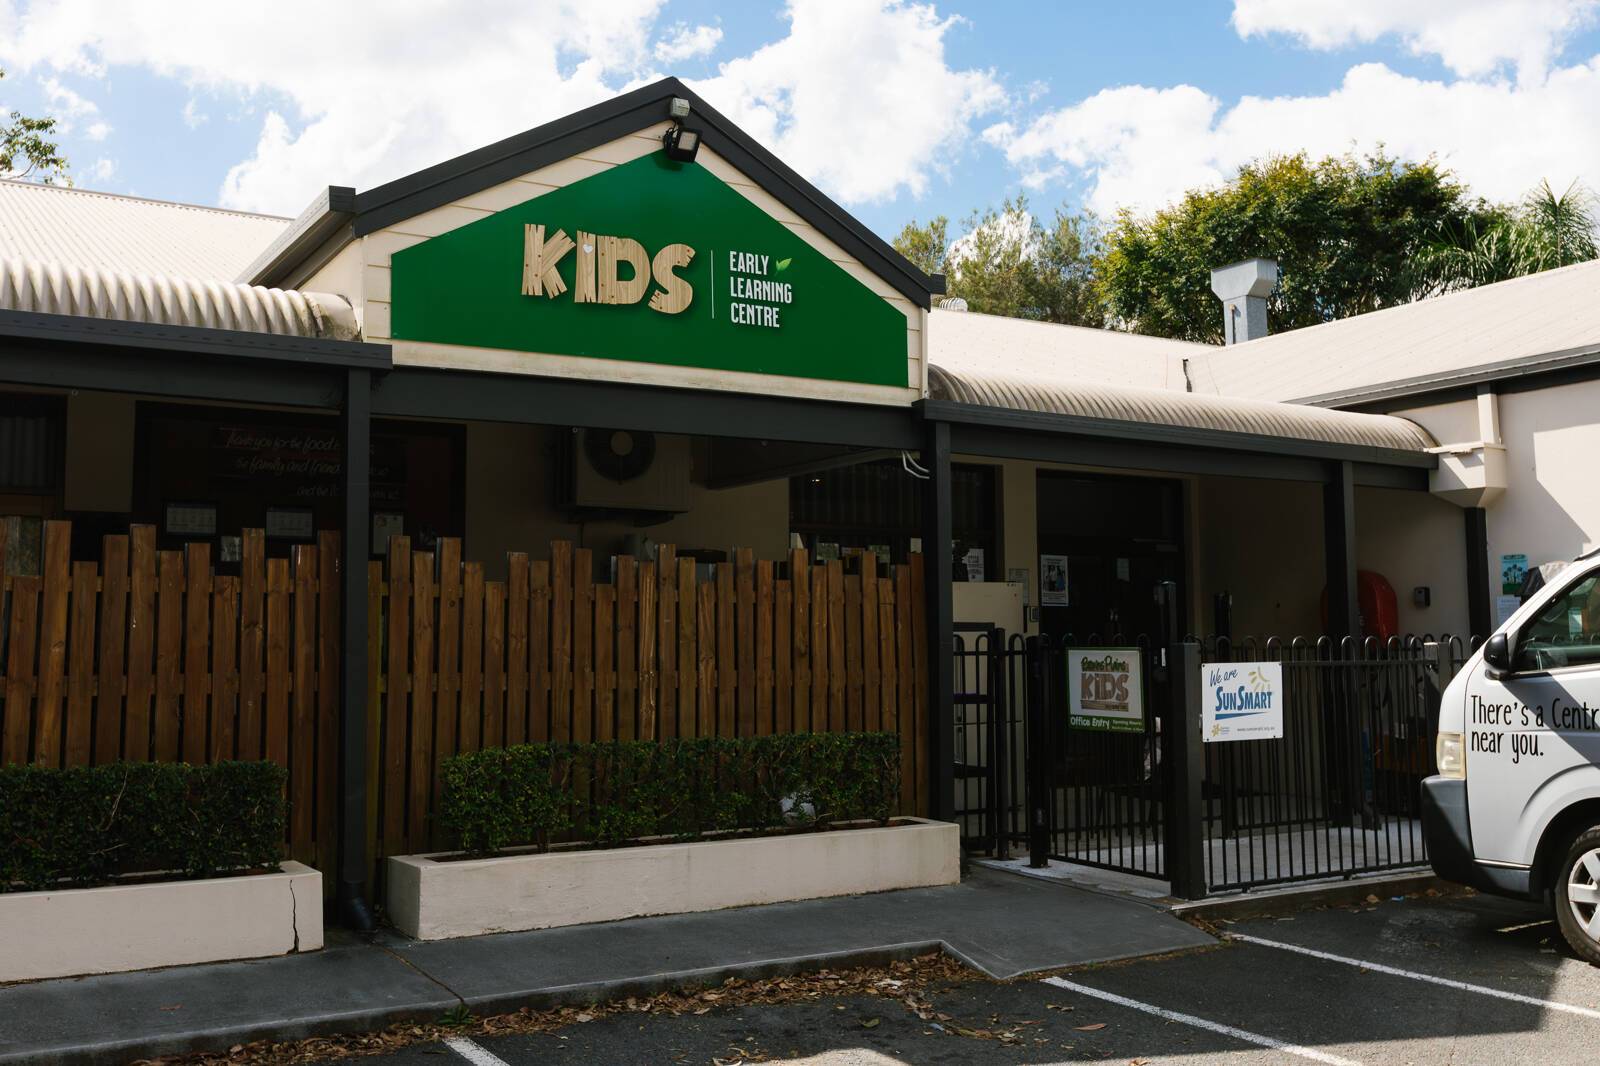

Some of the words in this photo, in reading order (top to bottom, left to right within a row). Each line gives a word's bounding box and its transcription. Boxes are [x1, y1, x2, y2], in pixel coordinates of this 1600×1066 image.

[521, 223, 696, 314] KIDS
[729, 250, 770, 276] EARLY
[730, 276, 793, 304] LEARNING
[730, 302, 781, 328] CENTRE
[1081, 673, 1129, 702] KIDS
[1210, 668, 1222, 687] We
[1223, 669, 1238, 681] are
[1070, 716, 1091, 728] Office
[1092, 717, 1110, 730] Entry
[1471, 695, 1529, 727] There's
[1535, 705, 1545, 728] a
[1471, 731, 1504, 754] near
[1511, 733, 1544, 764] you.
